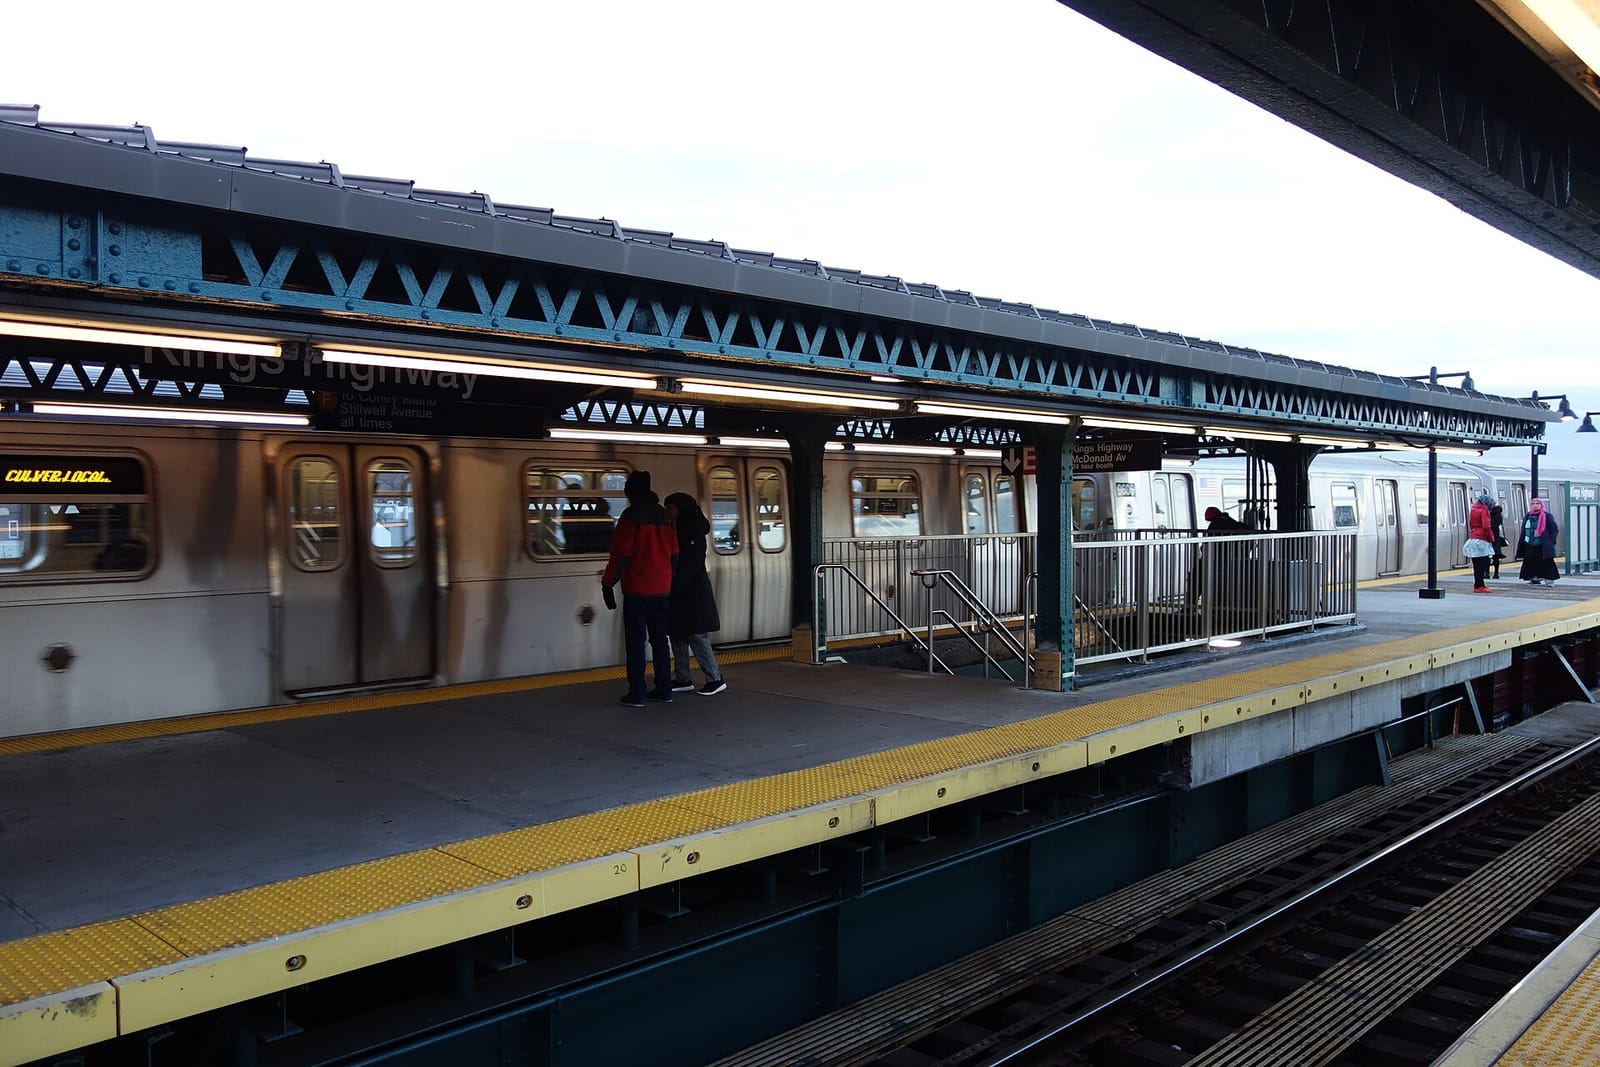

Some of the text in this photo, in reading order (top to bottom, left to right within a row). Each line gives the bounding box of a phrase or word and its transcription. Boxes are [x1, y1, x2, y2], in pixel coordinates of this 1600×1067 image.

[340, 402, 433, 418] Stillwell Avenue
[340, 416, 393, 430] all times
[1097, 442, 1133, 453] Highway
[1072, 453, 1127, 463] McDonald Av
[613, 863, 627, 875] 20
